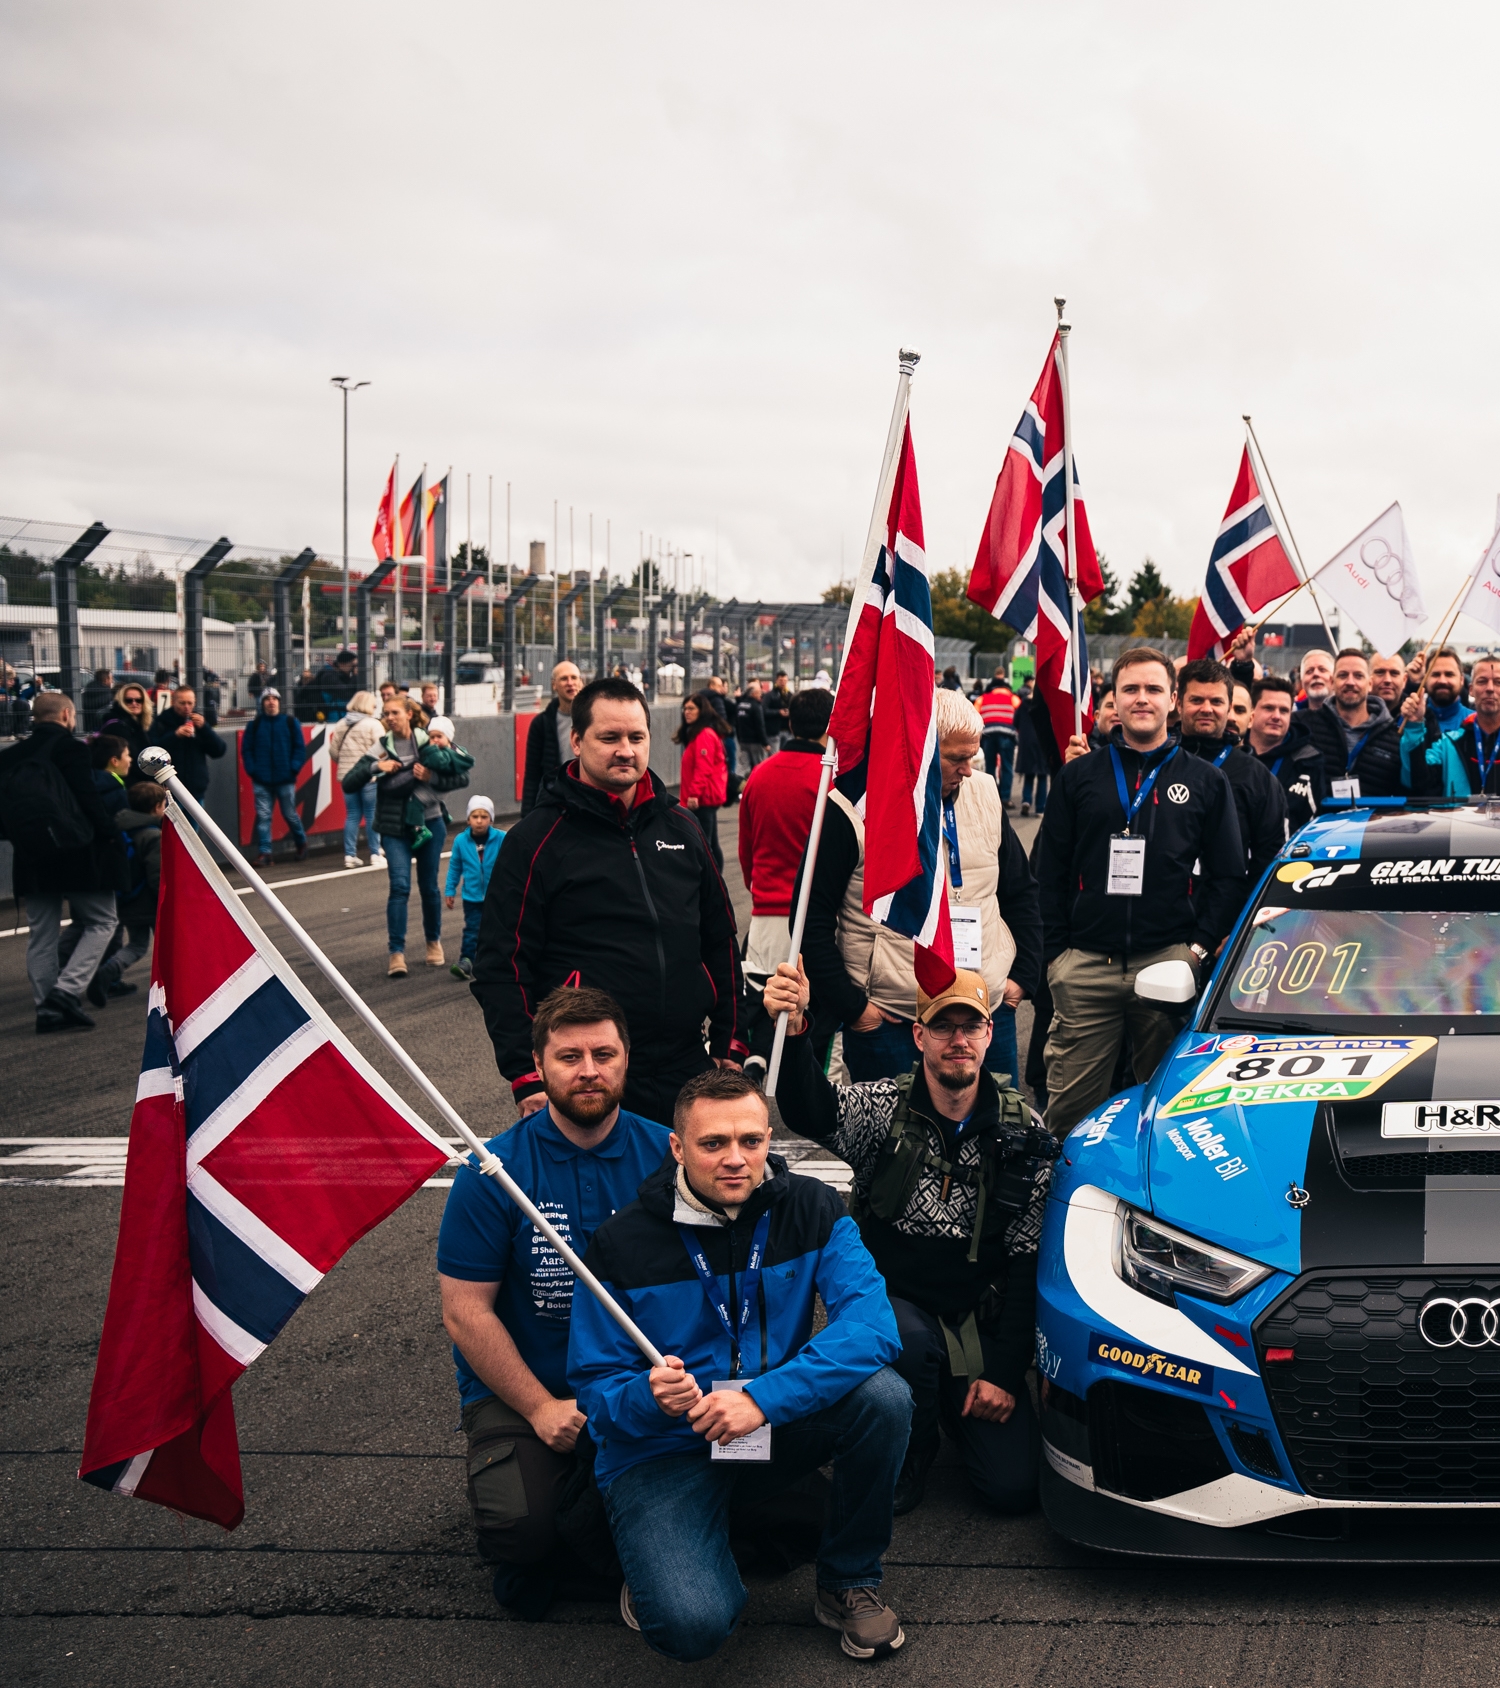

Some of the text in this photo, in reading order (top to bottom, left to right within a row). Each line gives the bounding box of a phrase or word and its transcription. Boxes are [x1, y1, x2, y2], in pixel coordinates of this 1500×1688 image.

[1344, 562, 1370, 589] Audi
[1370, 859, 1456, 878] GRAN
[1371, 877, 1399, 885] THE
[1443, 874, 1500, 882] DRIVING
[1238, 941, 1361, 994] 801
[1257, 1040, 1401, 1051] RAVENOL
[1227, 1054, 1373, 1081] 801
[1226, 1082, 1349, 1101] DEKRA
[1083, 1098, 1130, 1147] FALKEN
[1165, 1128, 1196, 1161] Motorsport
[1182, 1117, 1248, 1181] Moller Bil
[540, 1256, 565, 1265] Aars
[697, 1253, 707, 1271] Moller
[750, 1251, 758, 1269] Moller
[1098, 1343, 1202, 1385] GOODYEAR
